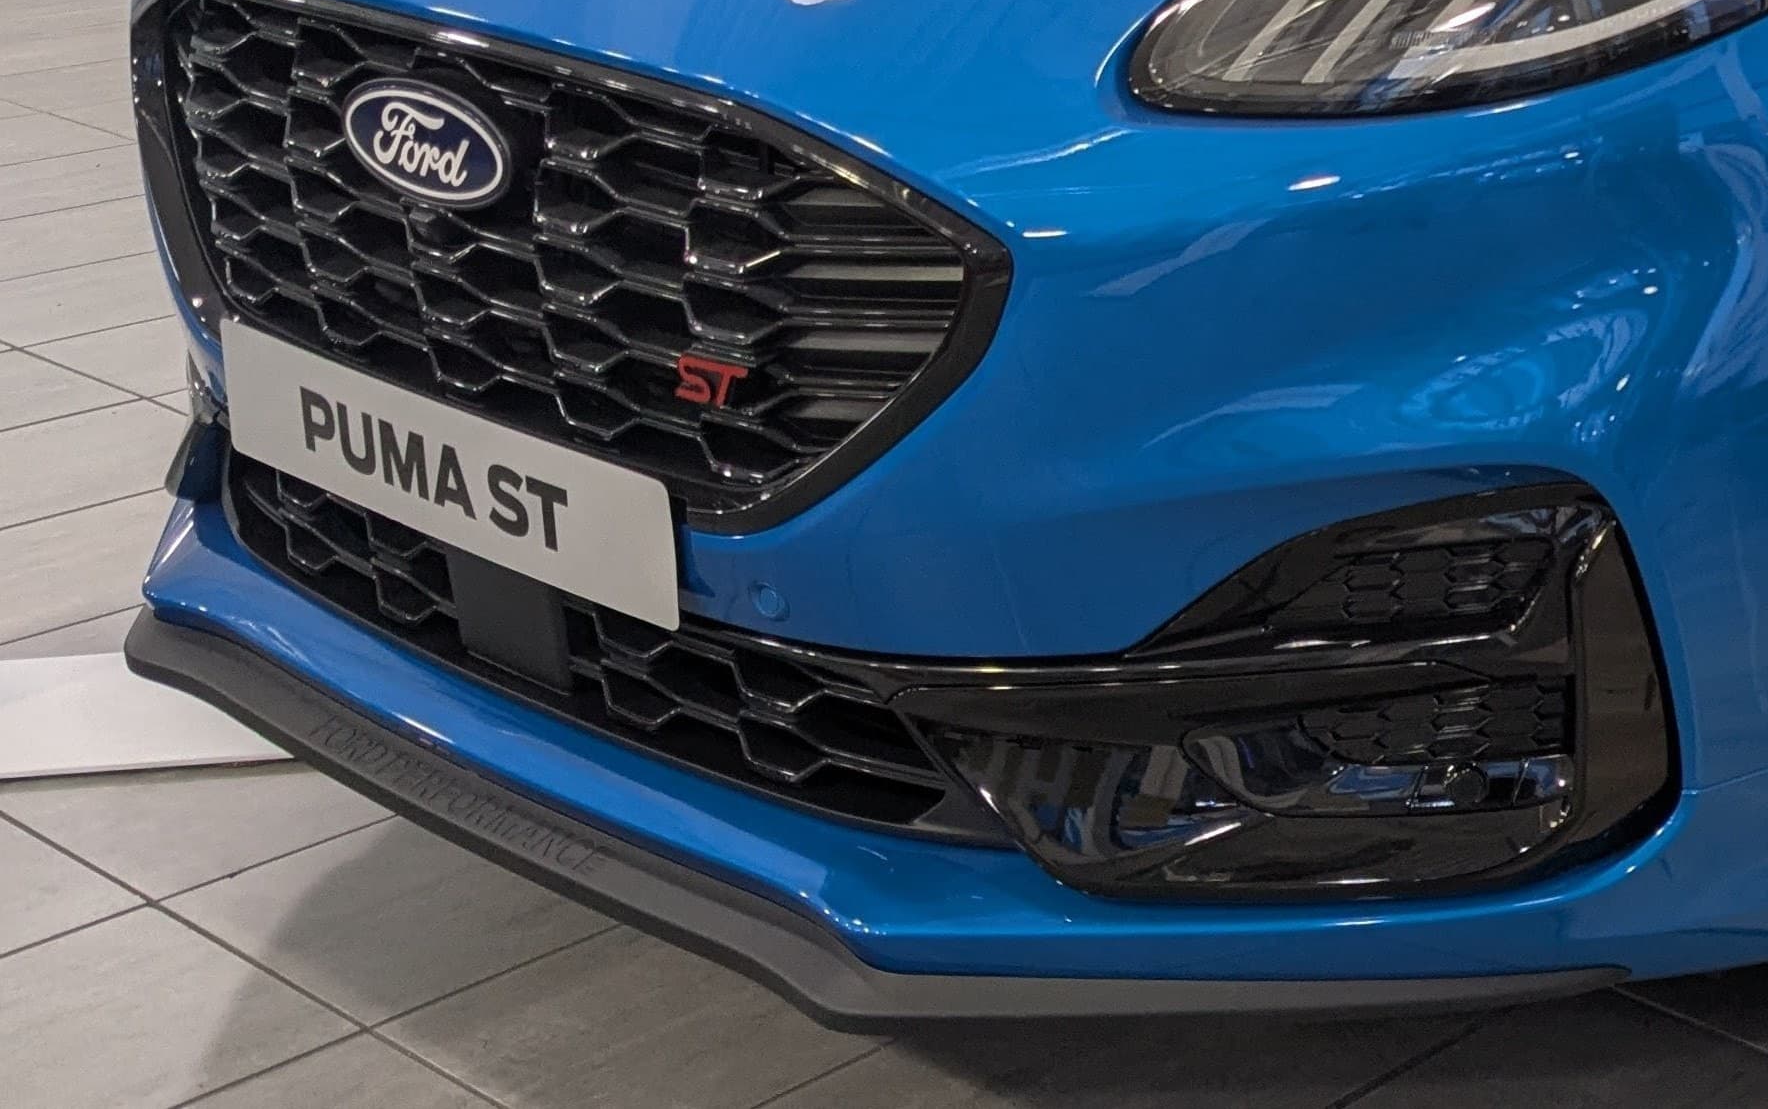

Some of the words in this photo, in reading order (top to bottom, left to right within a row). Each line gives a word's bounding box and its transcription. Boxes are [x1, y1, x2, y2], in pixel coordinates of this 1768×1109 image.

[373, 101, 470, 187] Ford
[675, 354, 749, 407] ST
[299, 385, 478, 521] PUMA
[487, 463, 569, 553] ST
